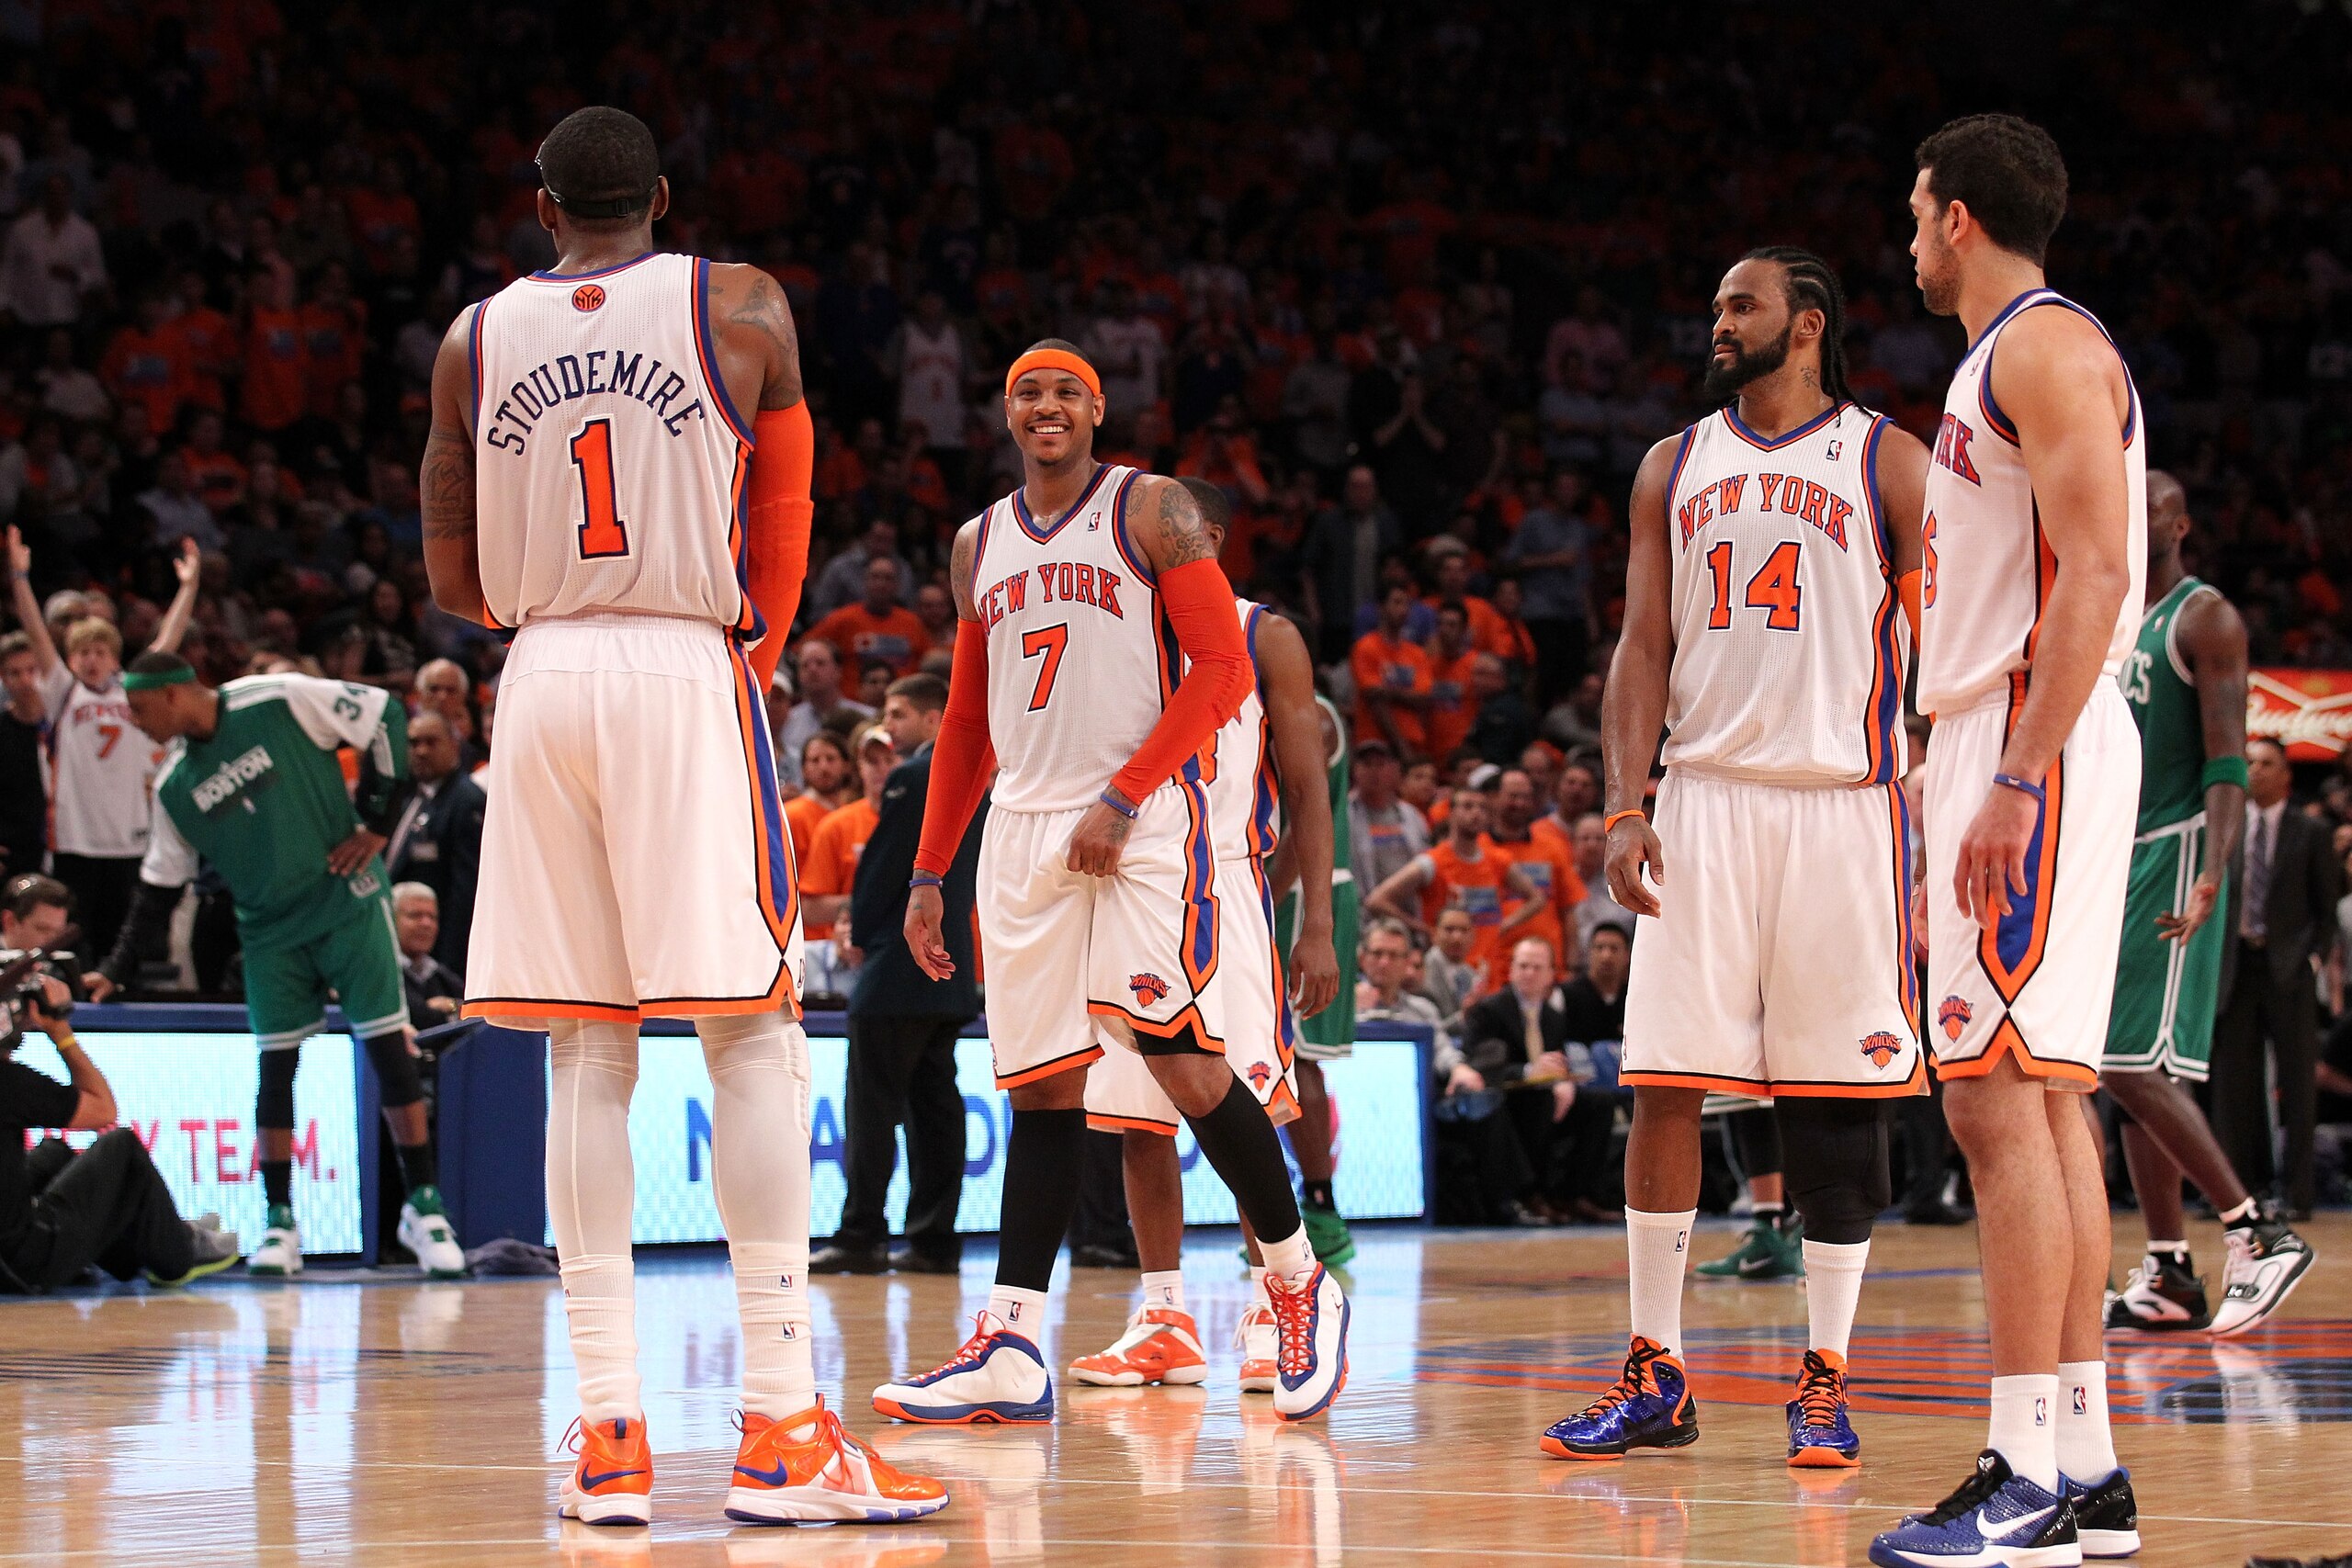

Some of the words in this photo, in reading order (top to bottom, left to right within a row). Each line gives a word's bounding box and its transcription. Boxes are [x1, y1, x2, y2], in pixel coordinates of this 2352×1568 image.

[487, 350, 705, 456] STOUDEMIRE
[570, 417, 630, 560] 1
[1679, 473, 1748, 556] NEW
[1758, 472, 1854, 554] YORK
[978, 570, 1029, 637] NEW
[1037, 562, 1124, 621] YORK
[1706, 540, 1803, 632] 14
[1022, 622, 1069, 713] 7
[97, 725, 121, 760] 7
[190, 744, 275, 814] BOSTON
[1130, 974, 1168, 998] KNICKS
[1861, 1033, 1902, 1054] KNICKS
